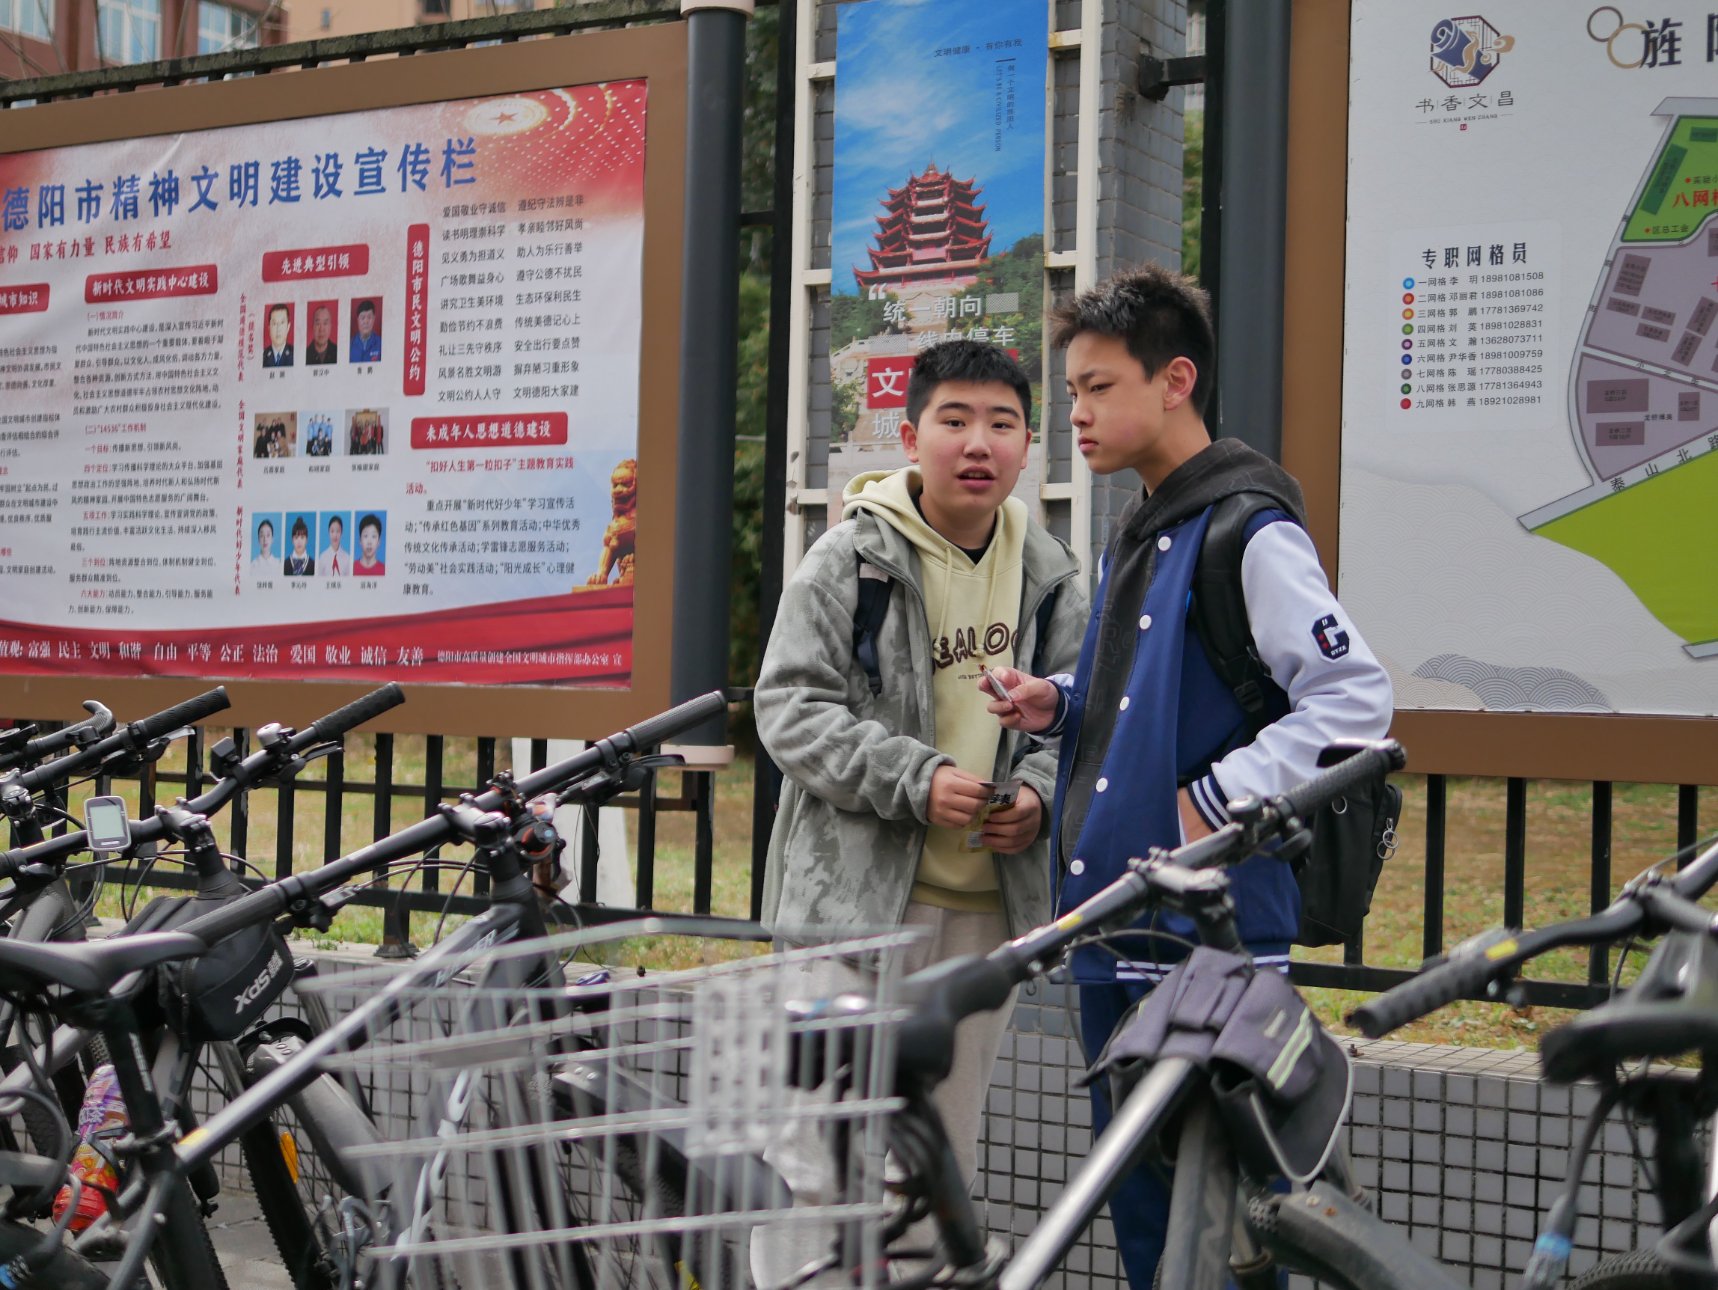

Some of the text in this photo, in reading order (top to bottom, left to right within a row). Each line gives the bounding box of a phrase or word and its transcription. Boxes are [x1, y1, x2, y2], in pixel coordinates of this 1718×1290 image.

[1415, 91, 1515, 114] 书香文昌
[2, 136, 477, 232] 德阳市精神文明建设宣传栏
[30, 237, 96, 260] 国家有力量
[104, 230, 172, 255] 民族有希望
[441, 242, 583, 266] 见义勇为担道义 助人为乐行善举
[1422, 242, 1527, 270] 专职网格员
[281, 252, 350, 276] 先进典型引领
[92, 271, 210, 296] 新时代文明实践中心建设
[440, 265, 582, 288] 广场歌舞益身心 遵守公德不扰民
[409, 240, 425, 382] 德阳市民文明公约
[440, 289, 581, 311] 讲究卫生美环境 生态环保利民生
[883, 293, 982, 323] 统一朝向
[438, 384, 579, 402] 文明公约人人守 文明德阳大家建
[426, 419, 552, 442] 未成年人思想道德建设
[28, 640, 51, 658] 富强
[58, 641, 81, 659] 民主
[88, 642, 111, 660] 文明
[118, 642, 142, 661] 和谐
[154, 643, 177, 662] 自由
[187, 642, 212, 662] 平等
[220, 643, 244, 663] 公正
[253, 643, 278, 664] 法治
[290, 644, 316, 665] 爱国
[325, 645, 351, 665] 敬业
[361, 646, 387, 666] 诚信
[397, 646, 424, 667] 友善
